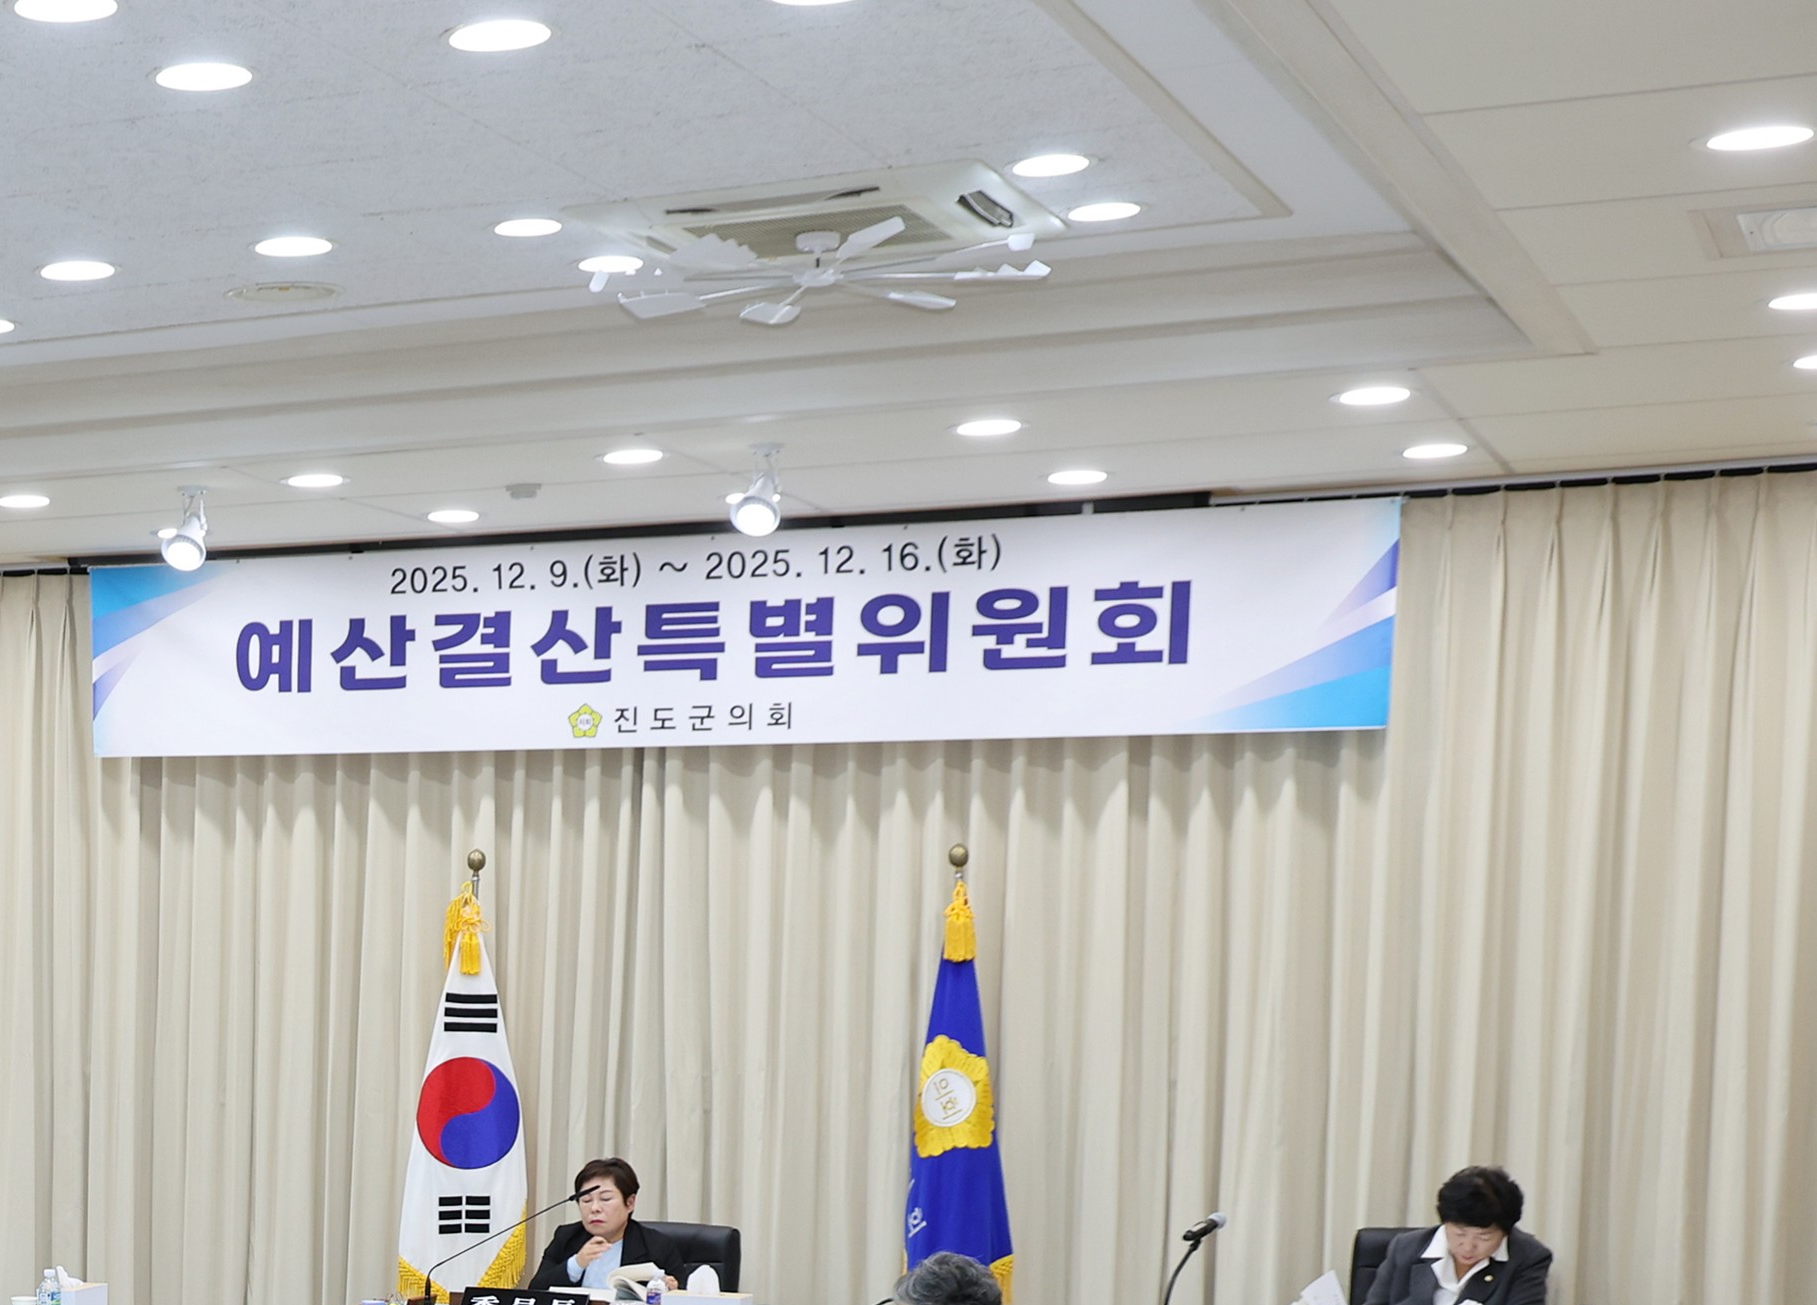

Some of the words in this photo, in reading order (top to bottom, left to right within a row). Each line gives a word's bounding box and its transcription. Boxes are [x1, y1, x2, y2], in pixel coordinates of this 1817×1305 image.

[390, 565, 480, 595] 2025.
[492, 563, 537, 592] 12.
[548, 552, 642, 589] 9.(화)
[705, 548, 803, 581] 2025.
[818, 545, 866, 576] 12.
[881, 533, 1004, 574] 16.(화)
[234, 579, 1194, 694] 예산결산특별위원회
[613, 700, 794, 734] 진도군의회
